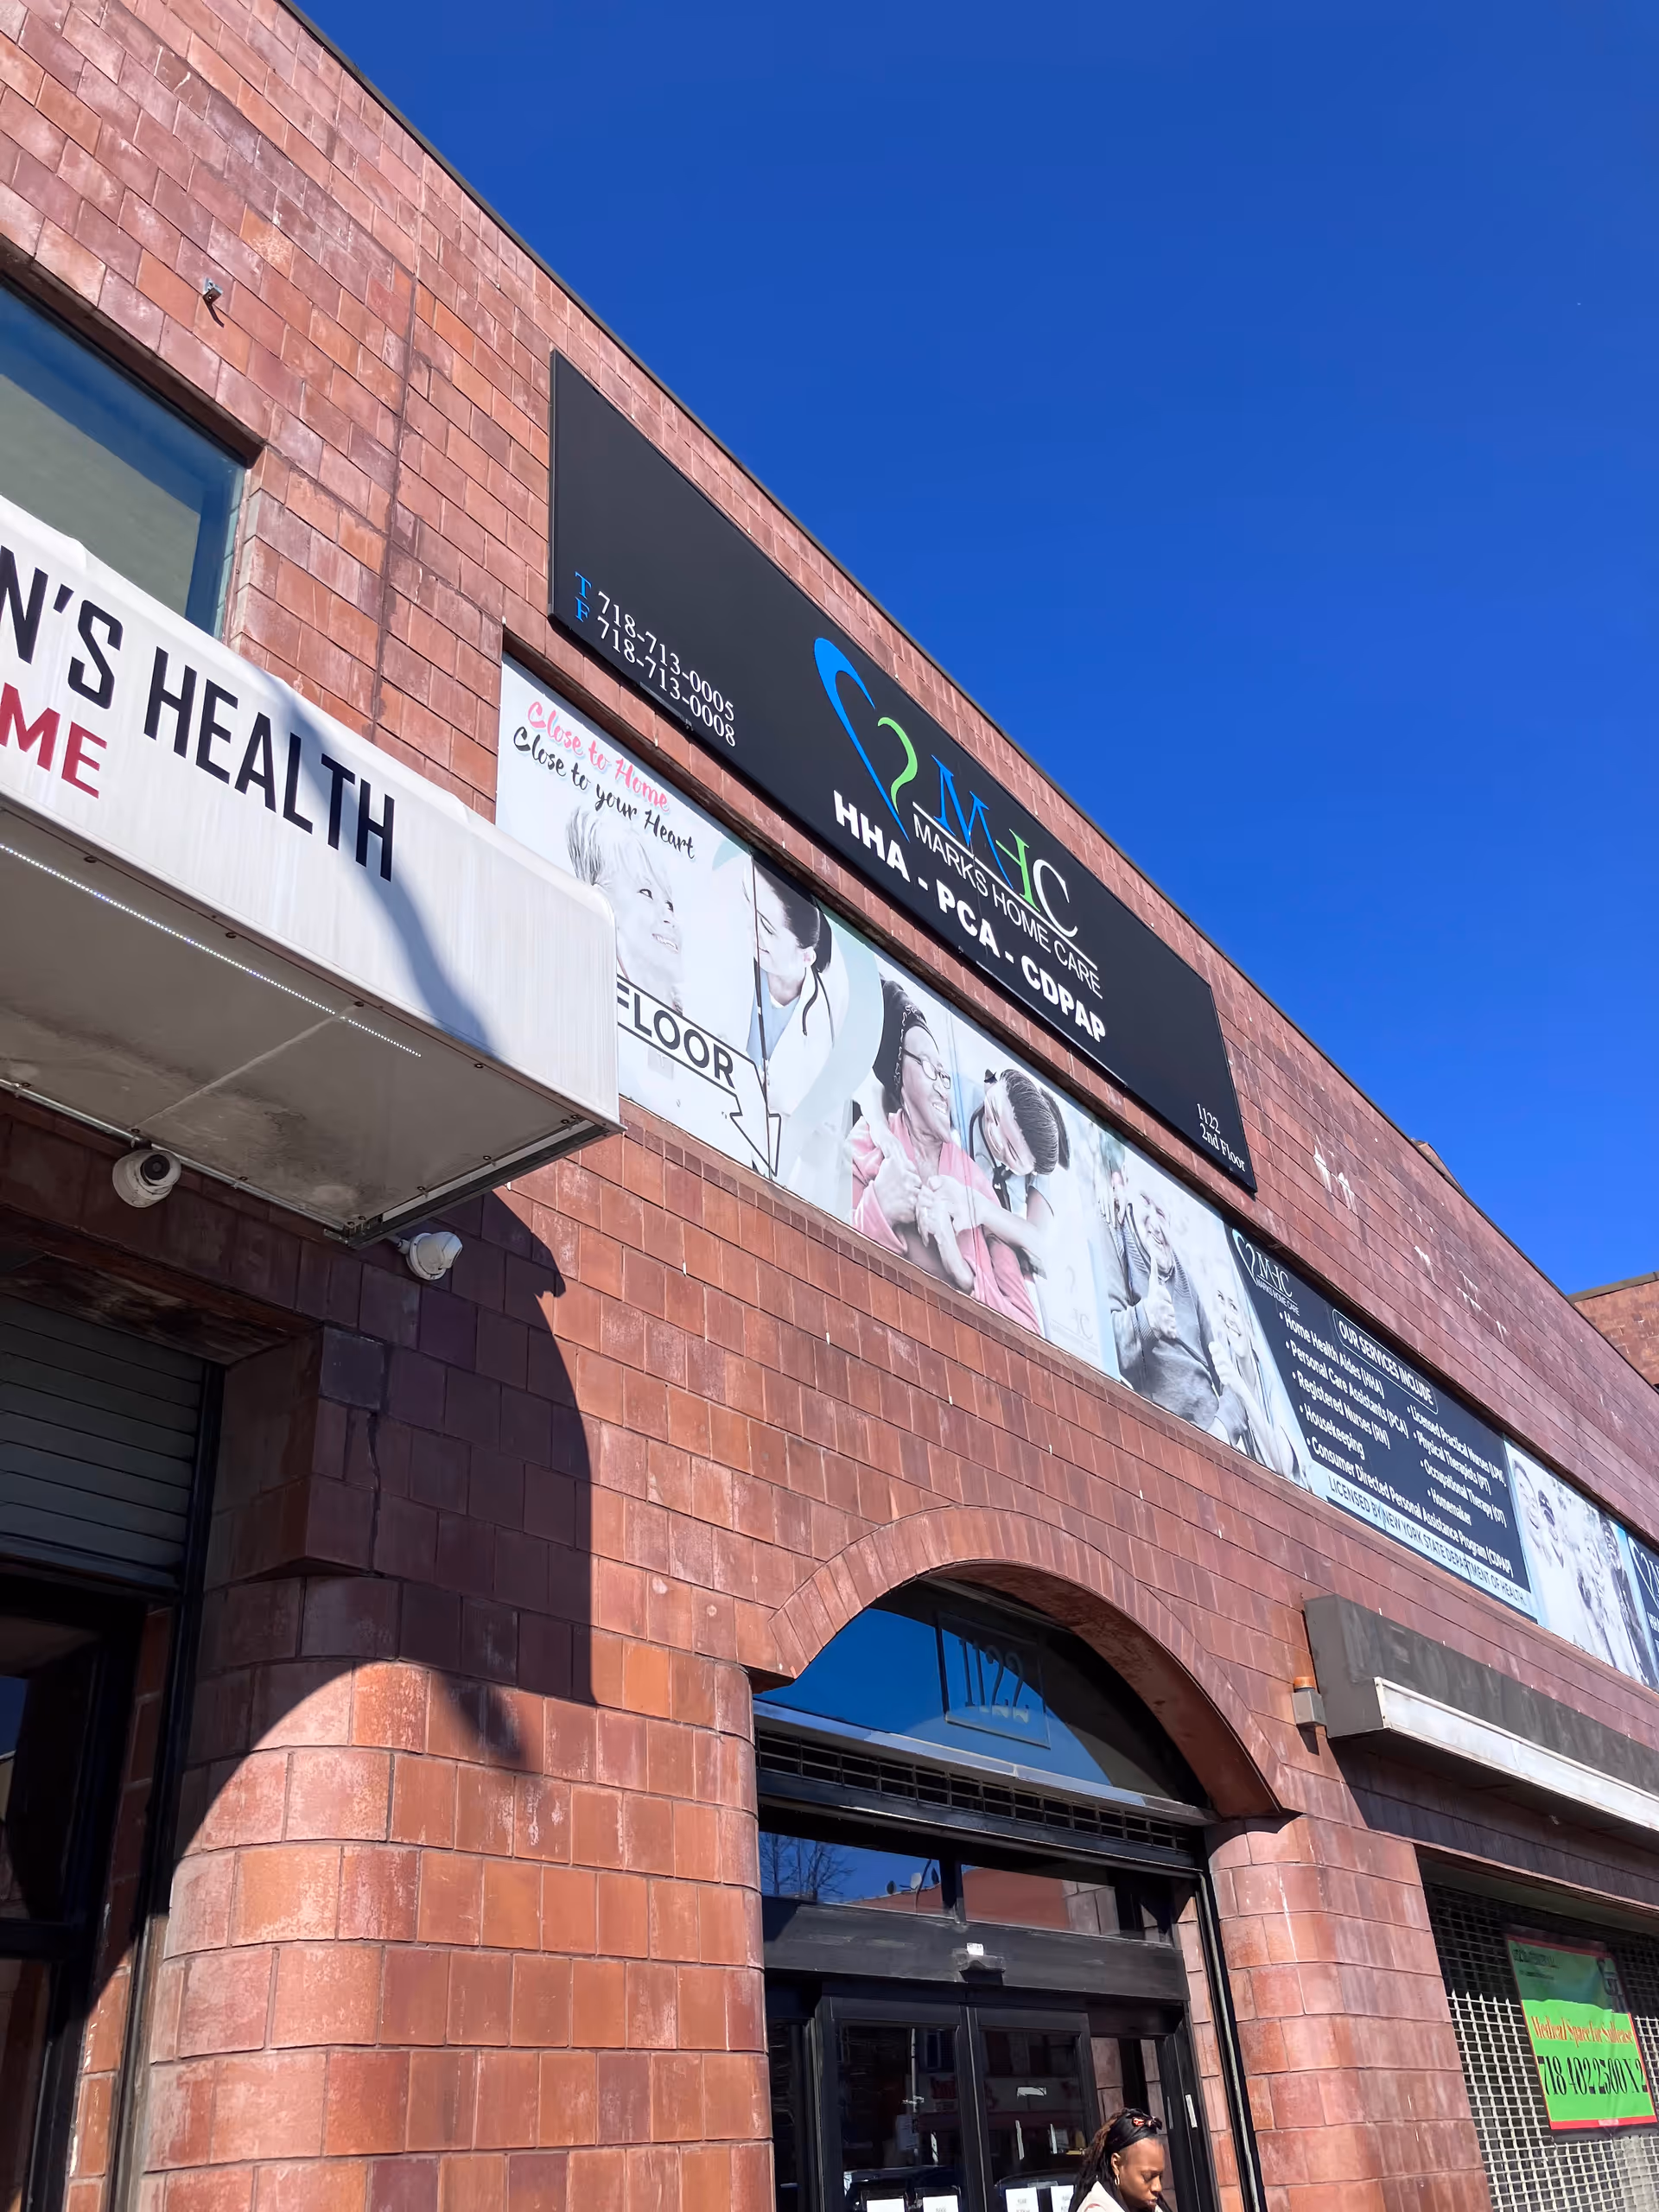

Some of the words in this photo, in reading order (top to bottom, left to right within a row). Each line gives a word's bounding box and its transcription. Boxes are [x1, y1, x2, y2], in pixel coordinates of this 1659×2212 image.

[575, 571, 592, 600] T
[598, 591, 734, 721] 718-713-0005
[575, 597, 590, 622] F
[597, 616, 735, 747] 718-713-0008
[0, 682, 107, 798] ME
[144, 646, 395, 882] HEALTH
[528, 702, 583, 755] Close
[588, 741, 608, 770] to
[615, 759, 669, 812] Home
[513, 727, 566, 776] Close
[571, 763, 591, 790] to
[594, 784, 637, 820] your
[645, 810, 695, 859] Heart
[834, 790, 910, 882] HHA
[936, 879, 1000, 958] PCA
[1021, 955, 1105, 1042] CDPAP
[913, 813, 988, 898] MARKS
[993, 883, 1052, 954] HOME
[1054, 941, 1103, 1000] CARE
[1197, 1103, 1220, 1135] 1122
[1199, 1122, 1220, 1150] 2nd
[1219, 1138, 1245, 1172] Floor
[1284, 1311, 1311, 1344] Home
[1311, 1331, 1338, 1363] Health
[1339, 1352, 1360, 1381] Aides
[1361, 1367, 1384, 1399] (HHA)
[1291, 1340, 1327, 1382] Personal
[1328, 1367, 1349, 1393] Care
[1349, 1382, 1387, 1422] Assistants
[1387, 1408, 1409, 1440] (PCA)
[1338, 1320, 1358, 1353] OUR
[1359, 1336, 1398, 1382] SERVICES
[1398, 1364, 1434, 1406] INCLUDE
[1296, 1370, 1344, 1416] Registered
[1344, 1404, 1371, 1433] Nurses
[1371, 1421, 1390, 1450] (RN)
[1304, 1403, 1365, 1460] Housekeeping
[1410, 1405, 1440, 1435] Licensed
[1440, 1425, 1469, 1459] Practical
[1468, 1446, 1490, 1474] Nurses
[1311, 1437, 1355, 1478] Consumer
[1355, 1463, 1390, 1500] Directed
[1389, 1485, 1422, 1521] Personal
[1422, 1505, 1459, 1543] Assistance
[1459, 1535, 1488, 1560] Program
[1328, 1476, 1370, 1515] LICENSED
[1370, 1503, 1381, 1522] BY
[1382, 1511, 1401, 1533] NEW
[1401, 1520, 1423, 1543] YORK
[1423, 1535, 1446, 1560] STATE
[1446, 1548, 1491, 1583] DEPARTMENT
[1491, 1574, 1501, 1589] OF
[1531, 2016, 1567, 2041] Medical
[1538, 2056, 1567, 2095] 718
